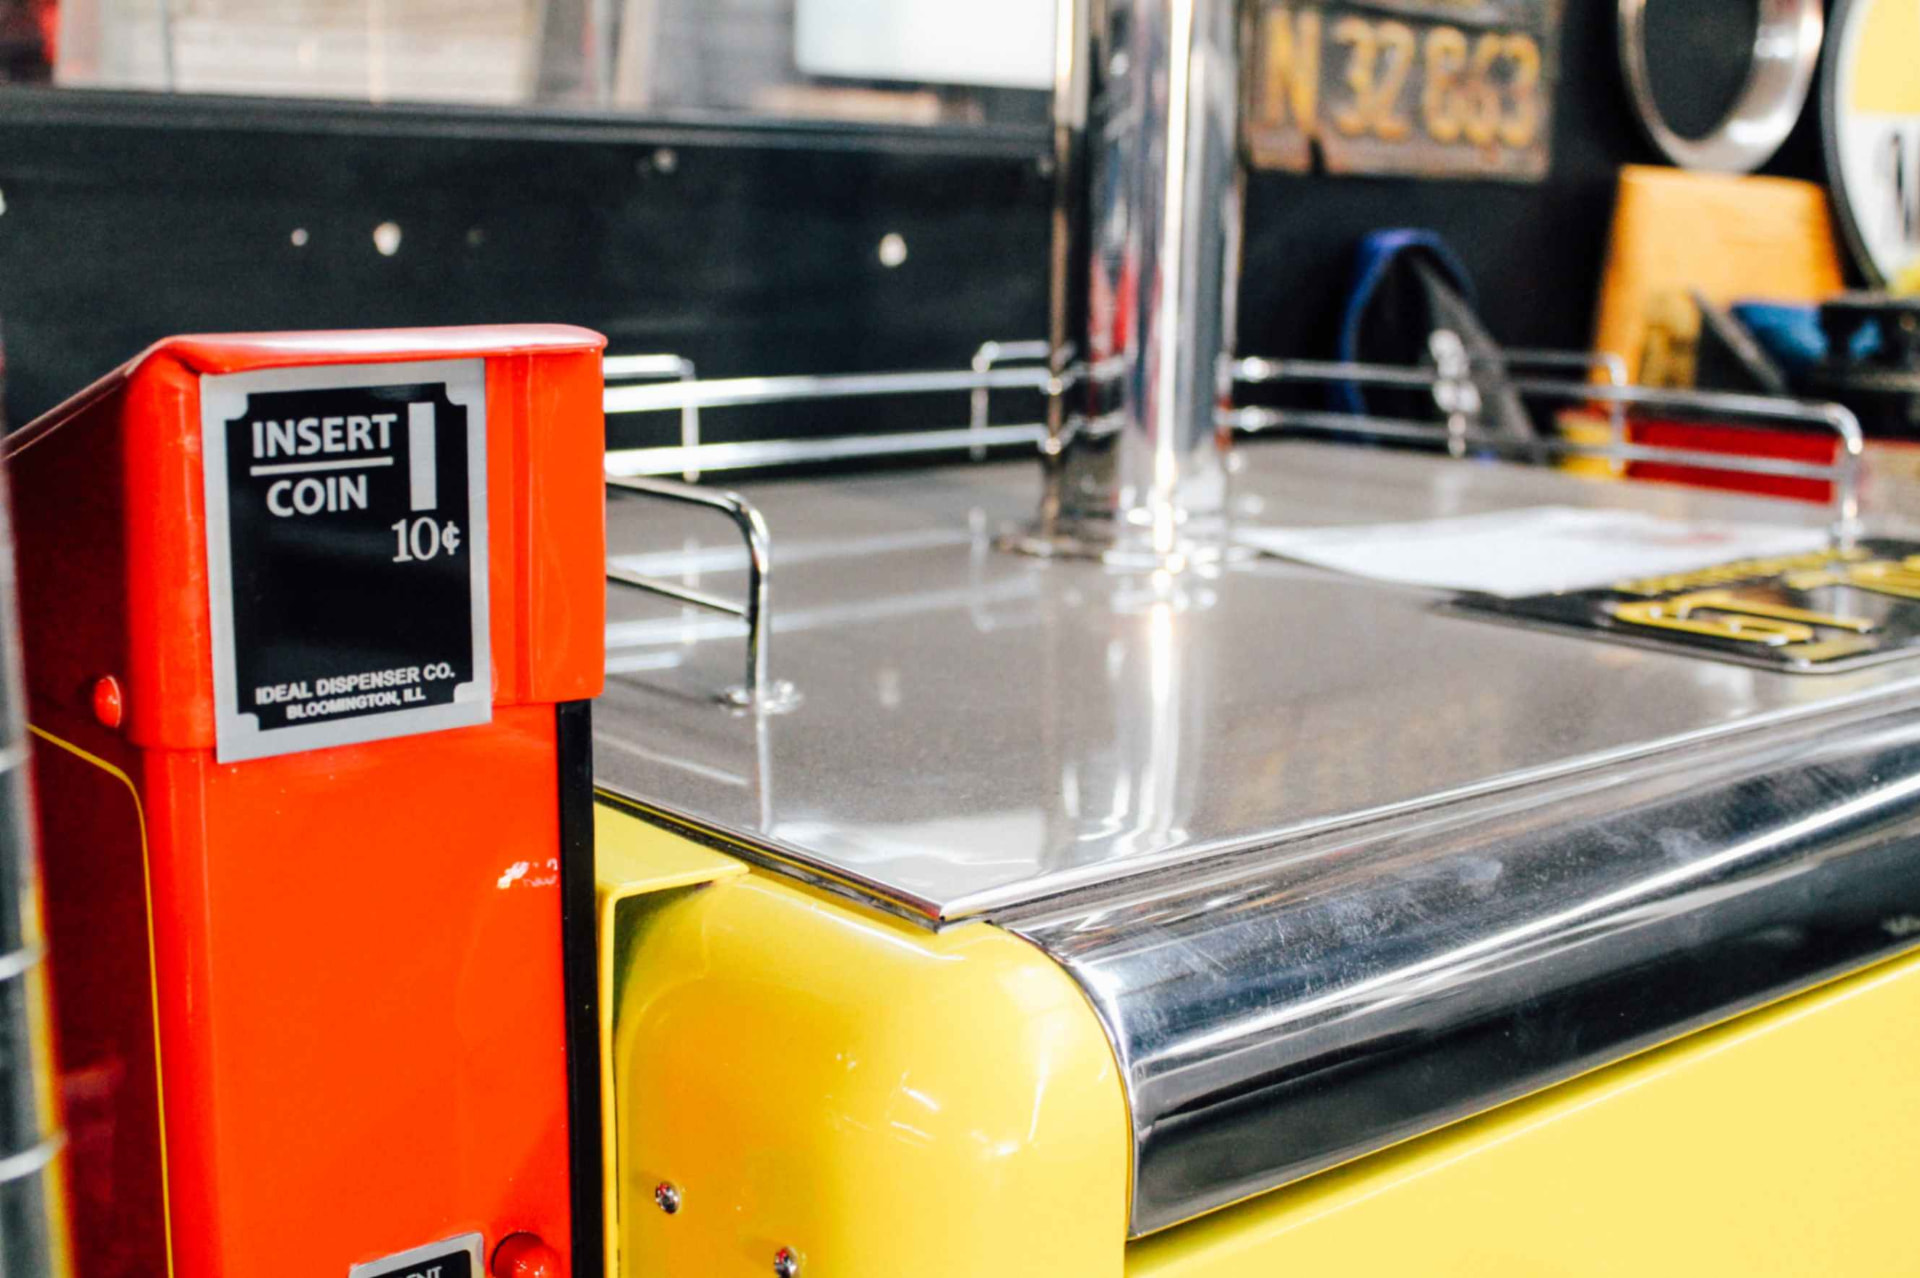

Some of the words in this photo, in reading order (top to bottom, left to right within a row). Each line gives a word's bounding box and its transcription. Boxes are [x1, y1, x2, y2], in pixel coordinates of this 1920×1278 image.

[251, 413, 398, 458] INSERT
[266, 475, 368, 517] COIN
[391, 516, 461, 563] 10¢
[255, 681, 314, 705] IDEAL
[316, 666, 420, 696] DISPENSER
[423, 662, 456, 681] CO.
[286, 691, 401, 720] BLOOMINGTON,
[403, 687, 426, 703] ILL
